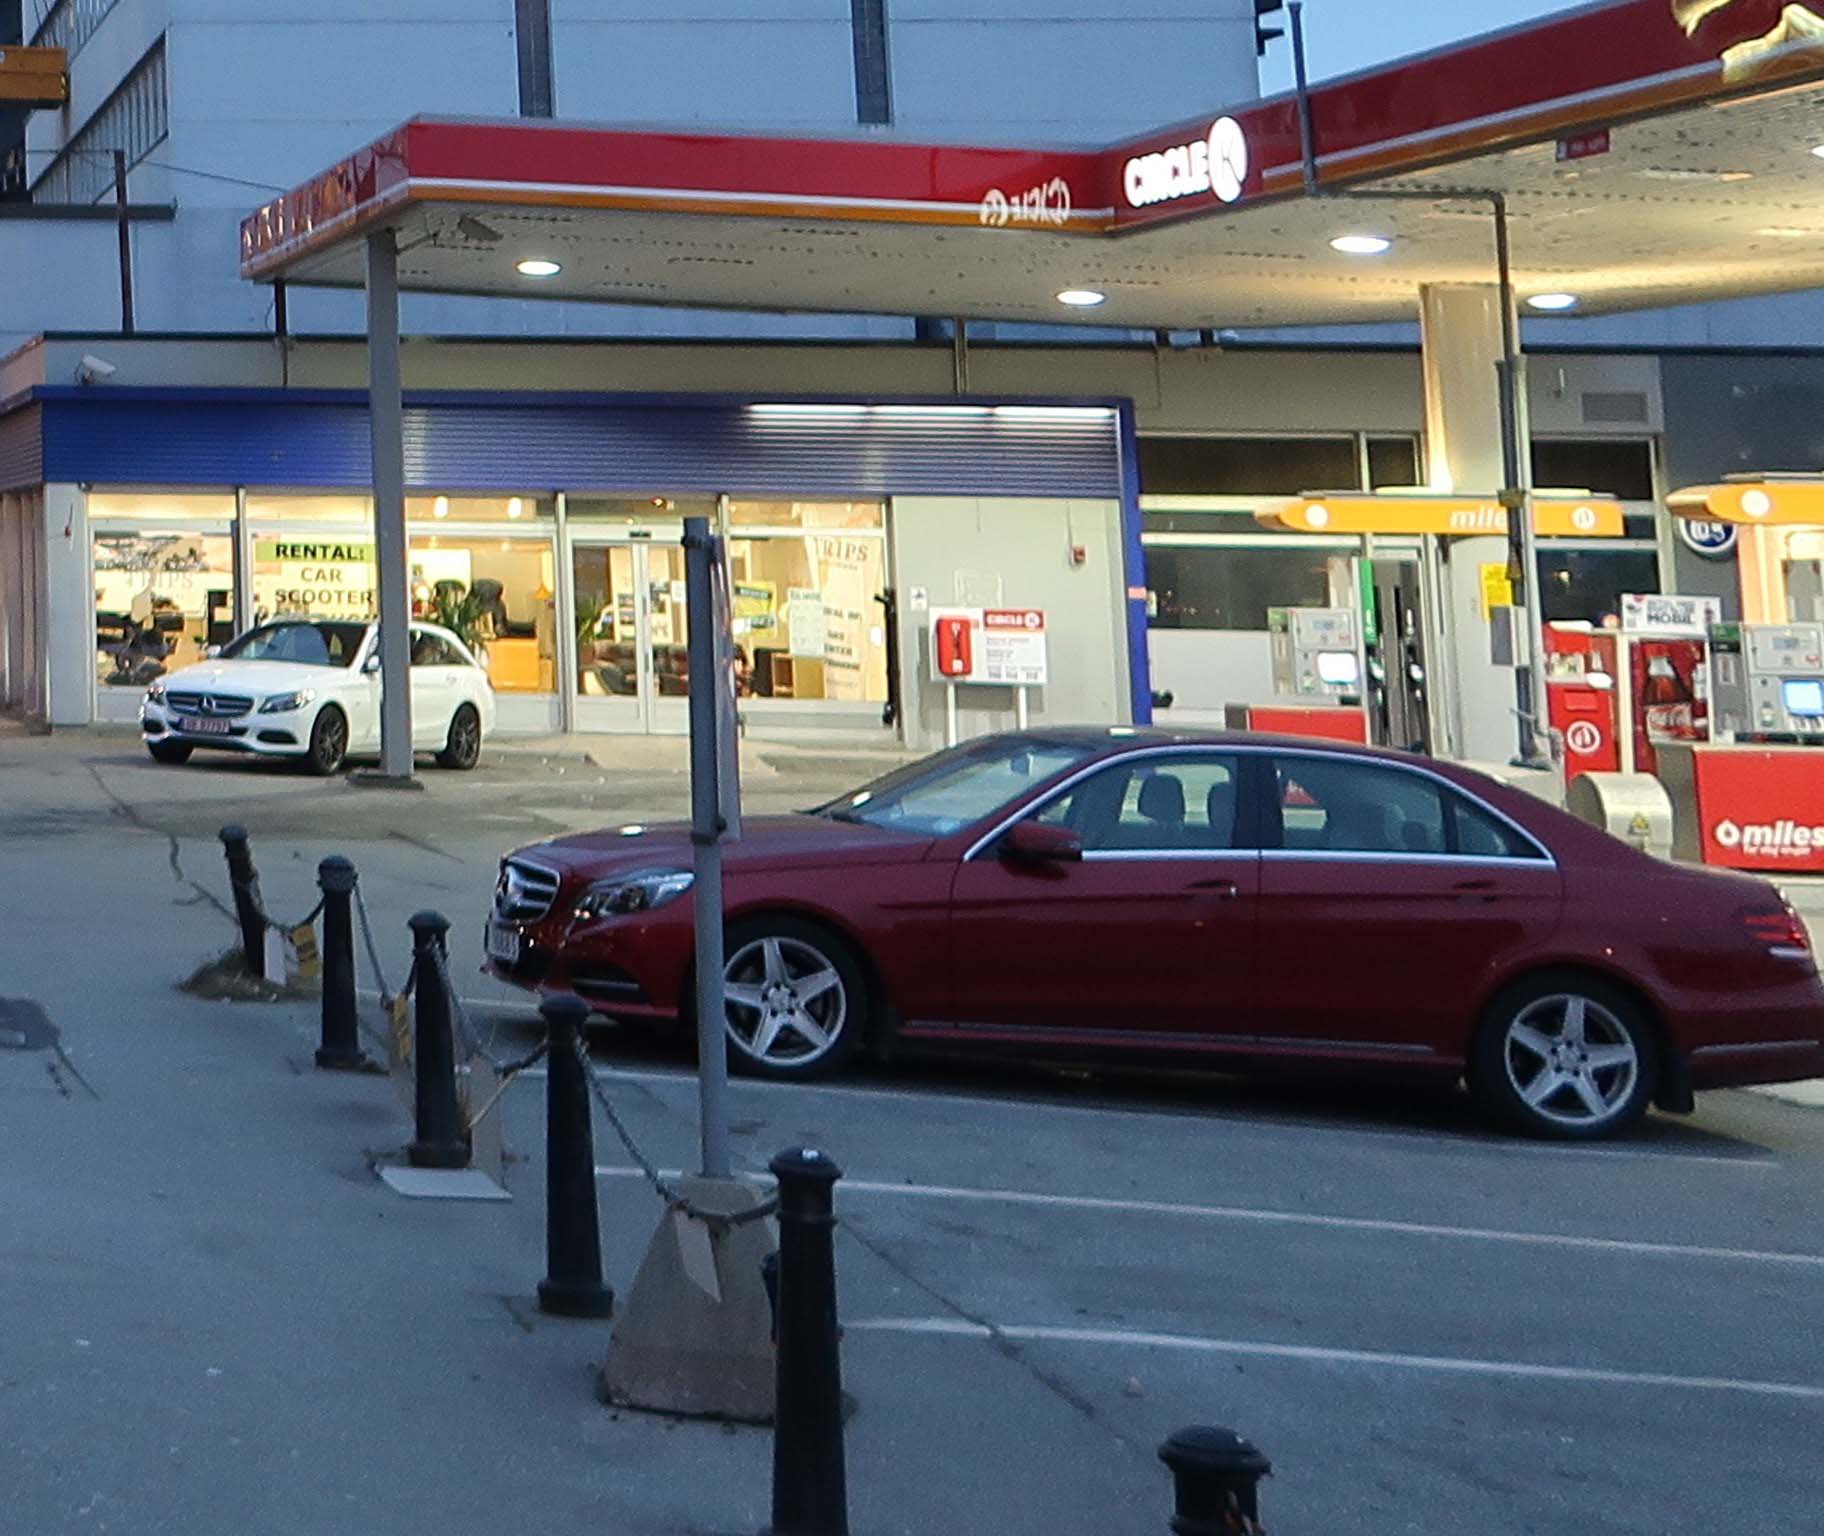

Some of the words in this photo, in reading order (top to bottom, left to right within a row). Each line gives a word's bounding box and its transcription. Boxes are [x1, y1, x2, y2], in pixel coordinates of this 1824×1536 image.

[1449, 505, 1507, 531] mile
[275, 544, 364, 561] RENTAL:
[301, 567, 342, 582] CAR
[275, 589, 374, 605] SCOOTER
[1743, 820, 1824, 848] miles
